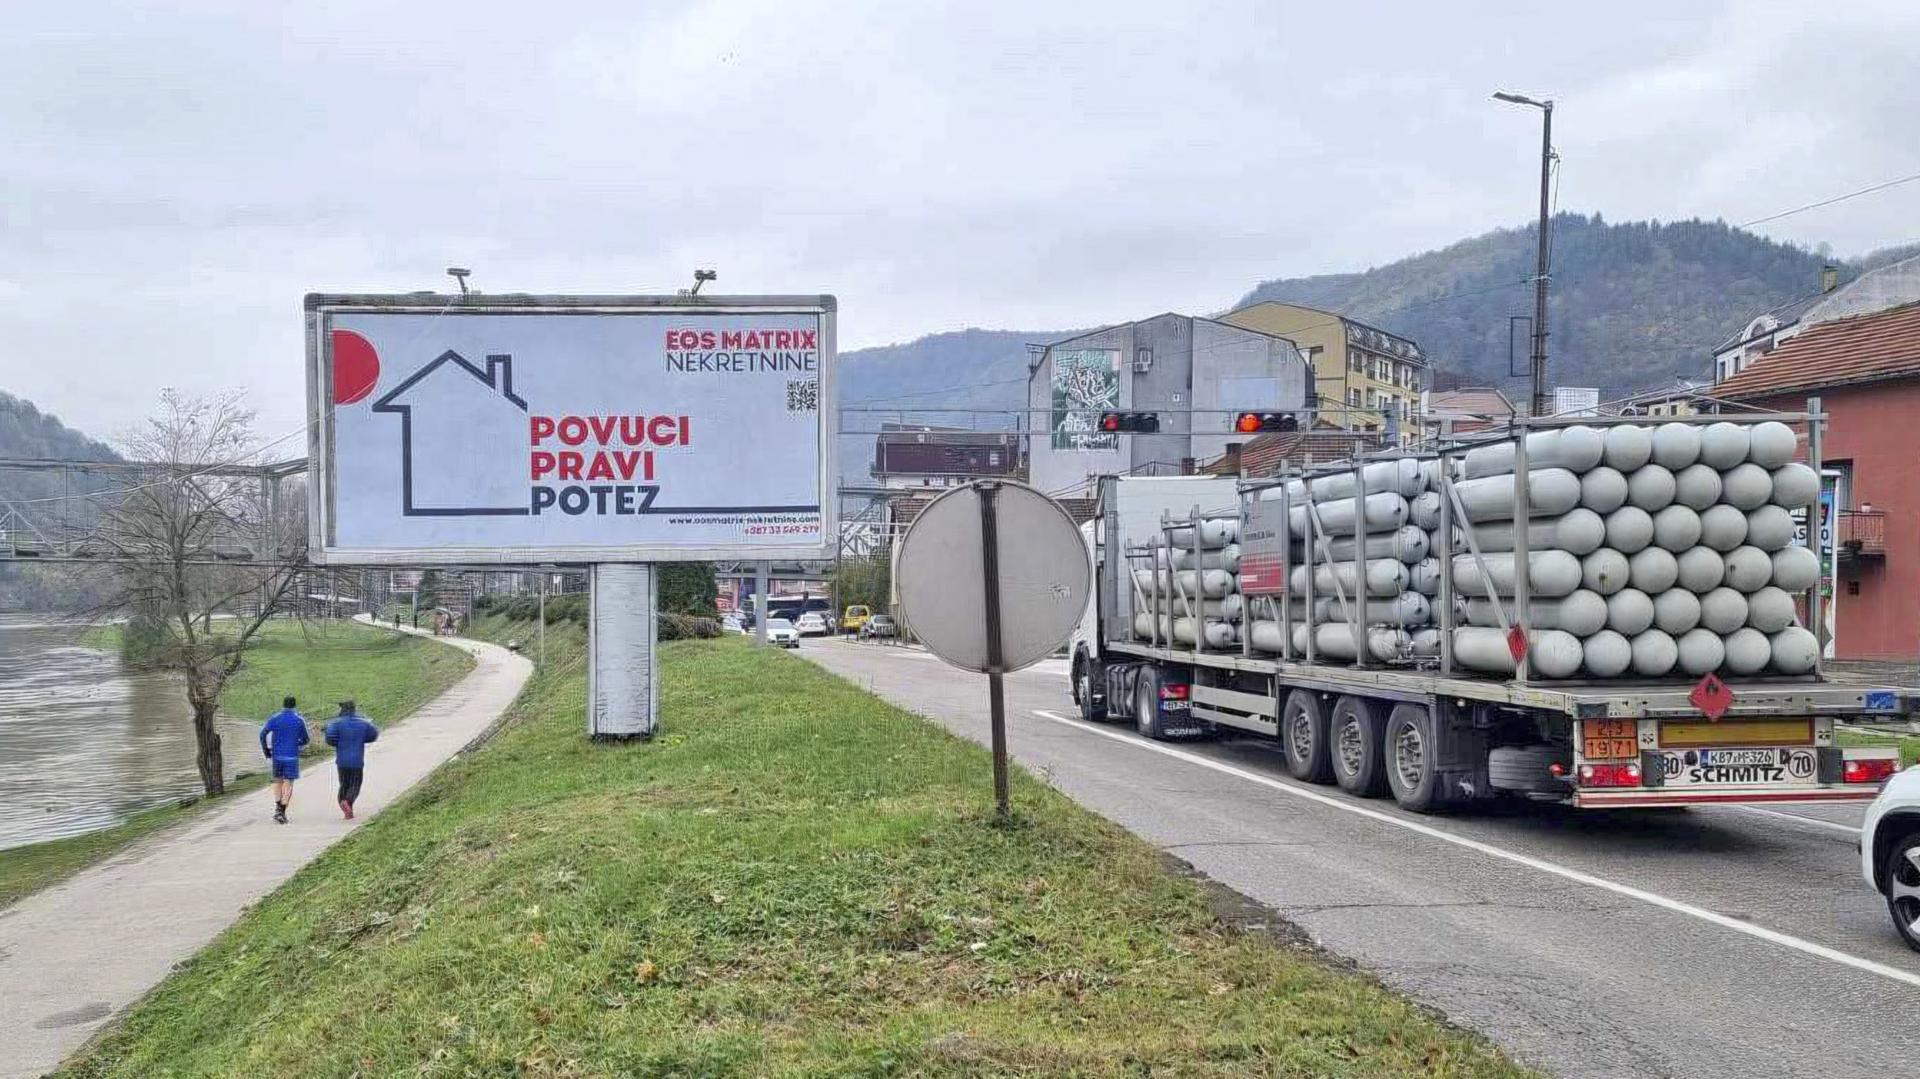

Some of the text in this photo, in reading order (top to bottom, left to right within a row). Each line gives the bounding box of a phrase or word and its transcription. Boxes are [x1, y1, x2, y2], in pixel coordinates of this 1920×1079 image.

[666, 329, 817, 350] EOS MATRIX
[666, 351, 817, 372] NEKRETNINE
[530, 415, 689, 446] POVUCI
[531, 450, 654, 481] PRAVI
[531, 485, 660, 515] POTEZ
[1587, 740, 1633, 757] 1971
[1689, 766, 1785, 783] SCHMITZ
[1793, 755, 1812, 774] 70
